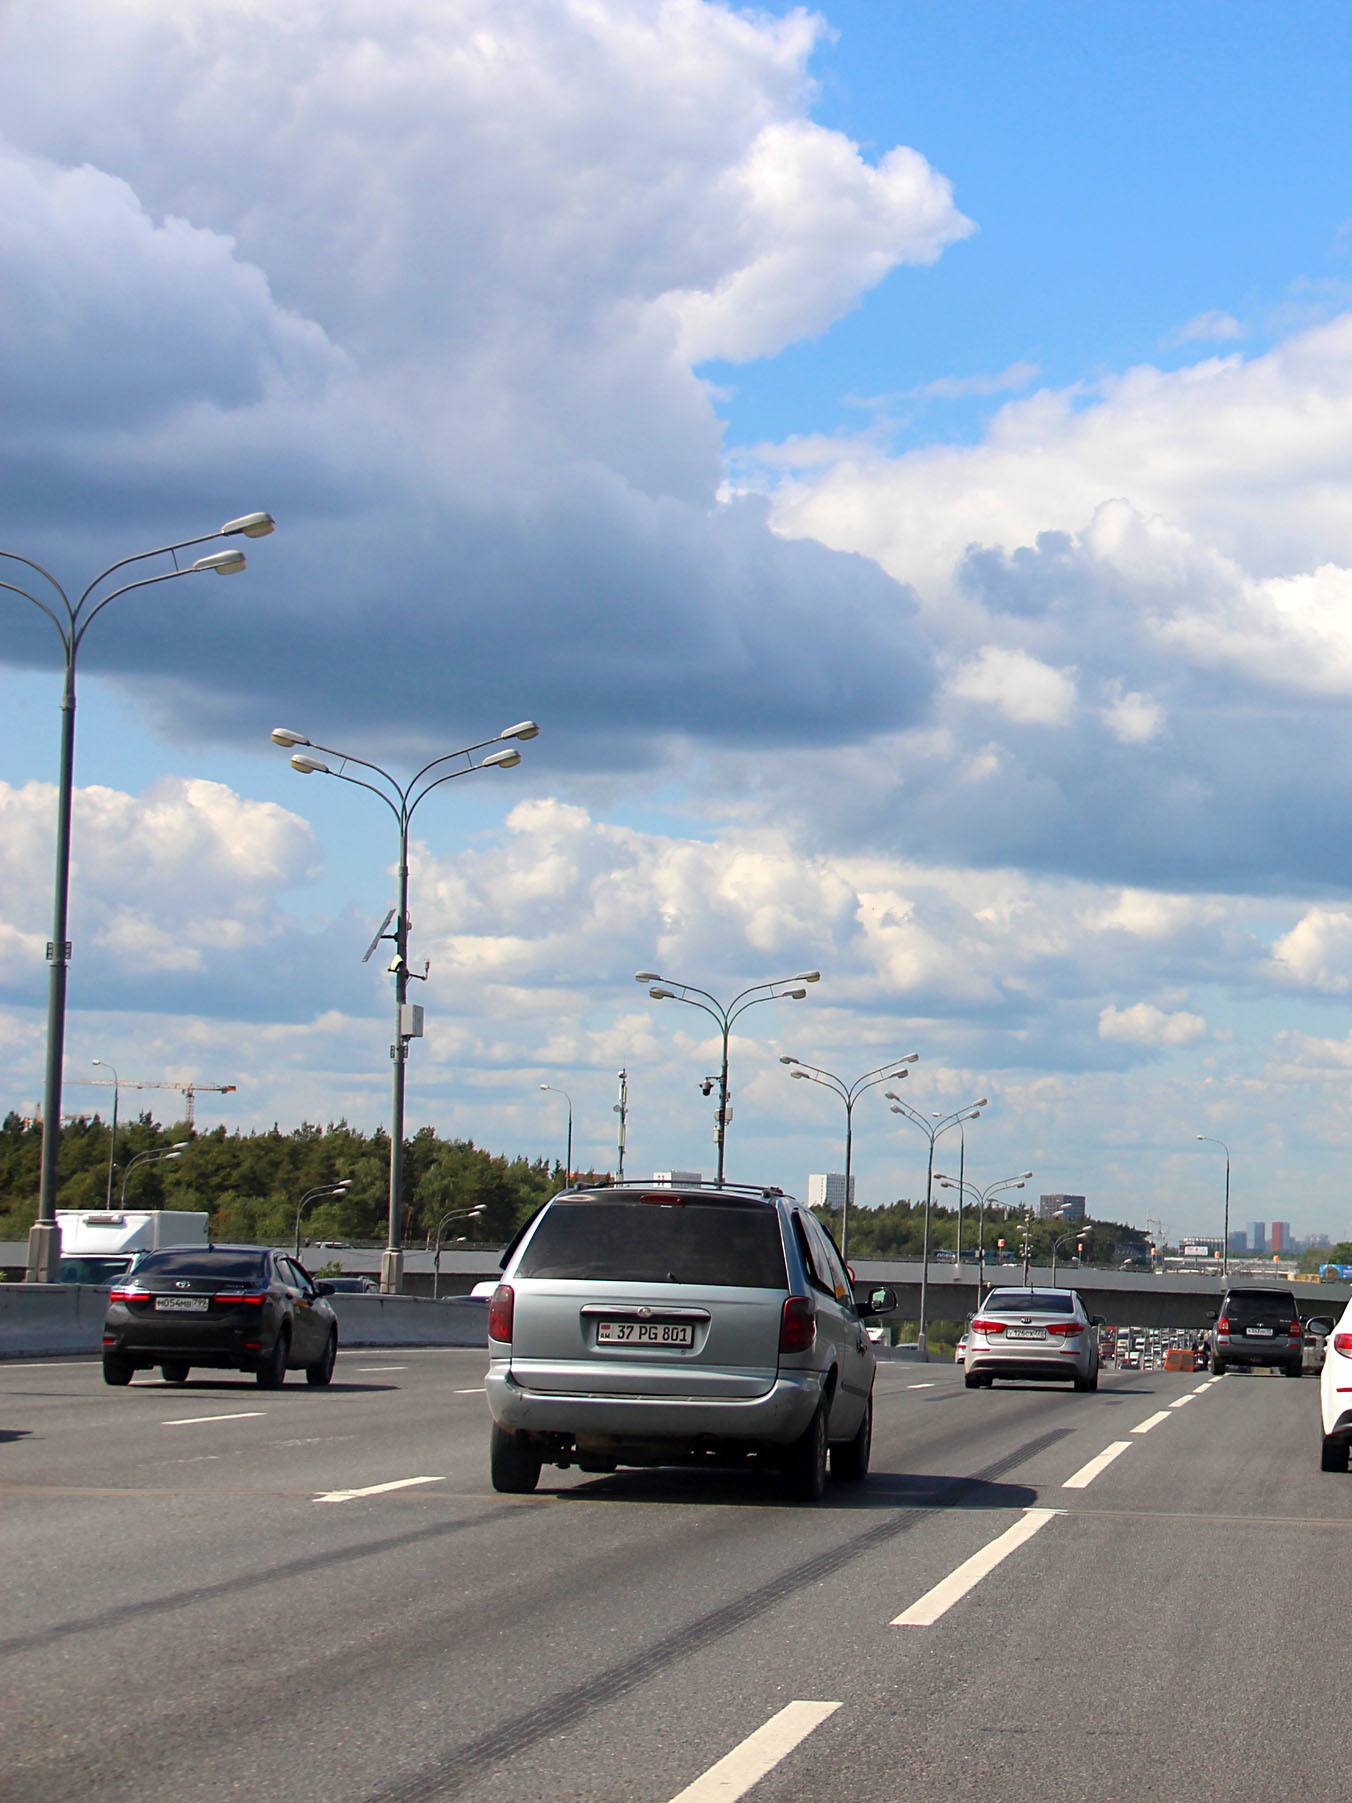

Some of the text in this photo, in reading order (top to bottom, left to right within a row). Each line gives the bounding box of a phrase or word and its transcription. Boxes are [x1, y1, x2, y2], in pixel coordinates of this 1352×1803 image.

[617, 1325, 687, 1341] 37 PG 801
